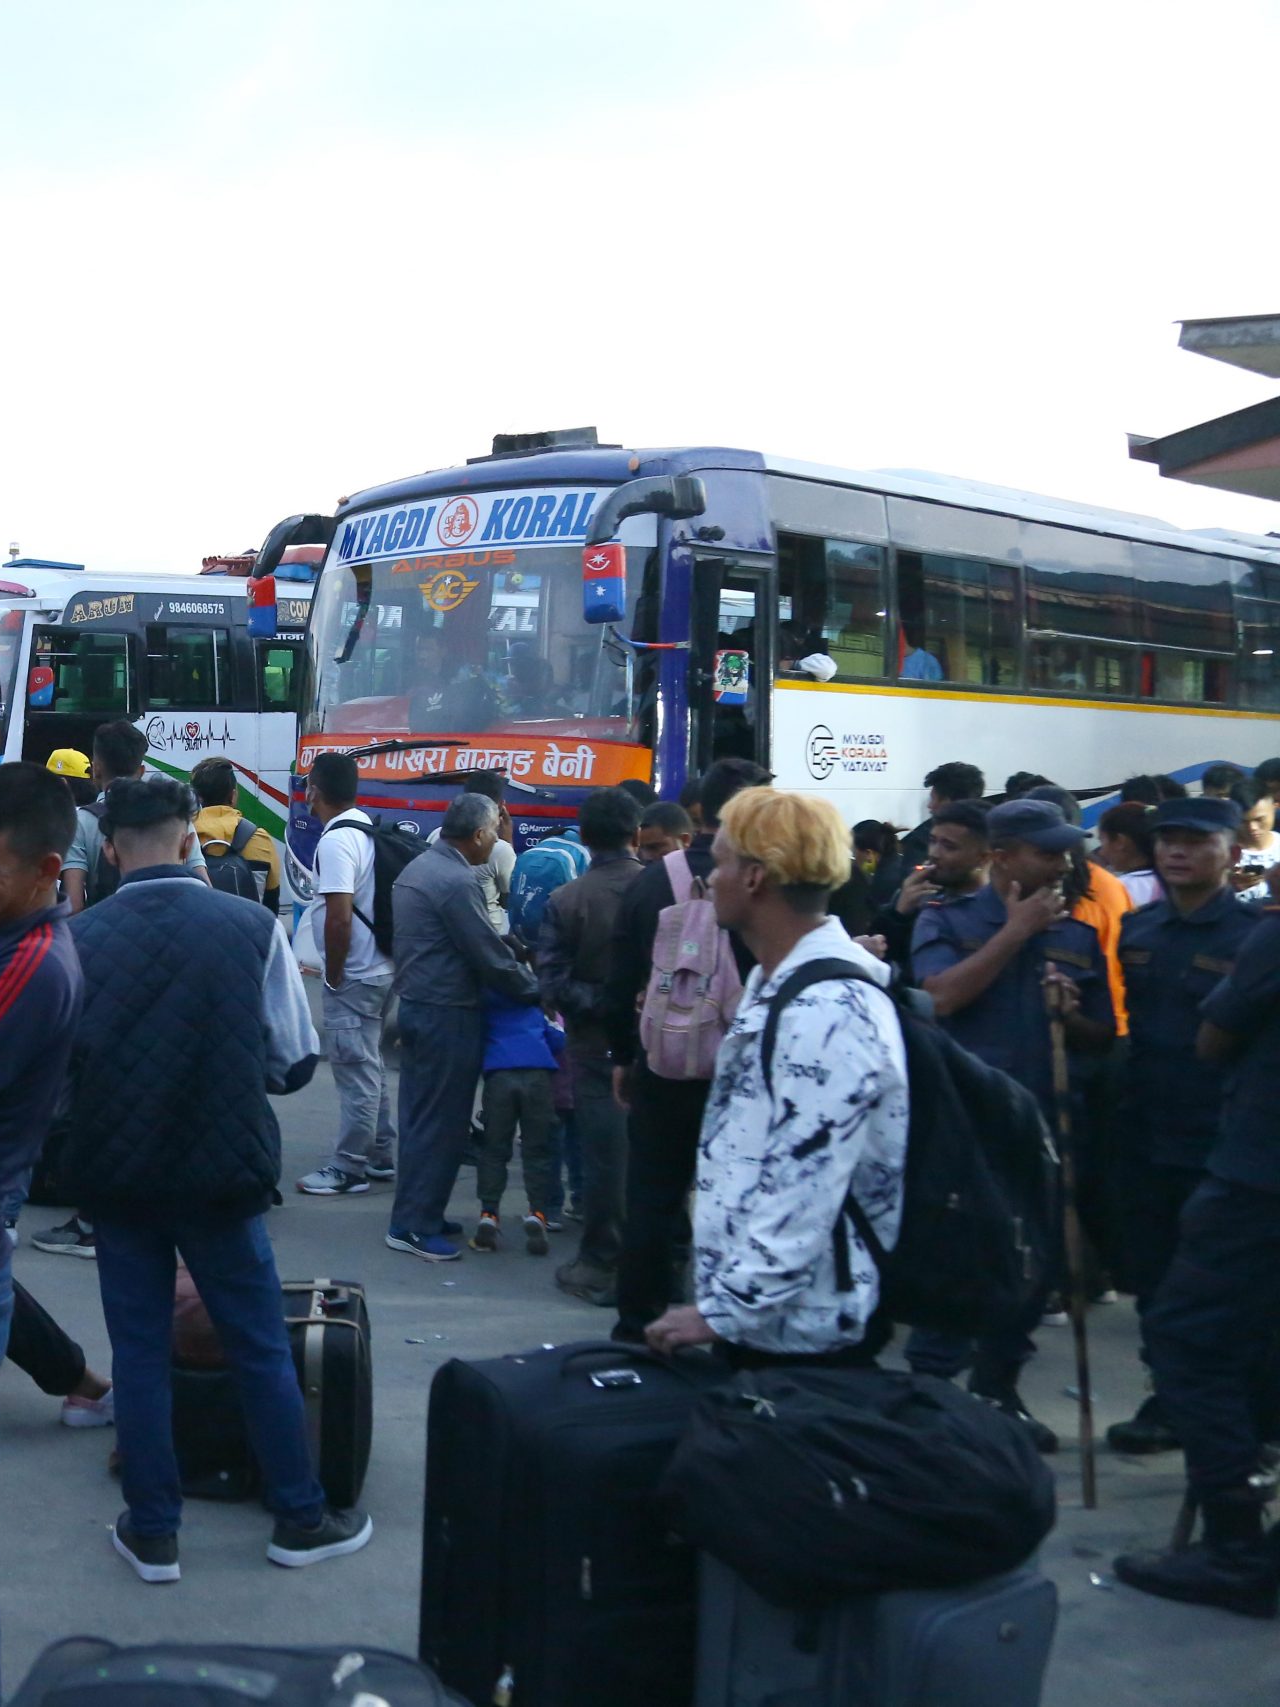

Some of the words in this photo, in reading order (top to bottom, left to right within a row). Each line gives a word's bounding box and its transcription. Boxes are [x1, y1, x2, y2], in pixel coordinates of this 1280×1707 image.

[337, 506, 437, 561] MYAGDI
[392, 550, 516, 574] AIRBUS
[434, 582, 462, 600] AC
[70, 594, 135, 623] ARUN
[169, 602, 225, 614] 9846068575
[843, 734, 885, 745] MYAGDI
[542, 743, 596, 780] बेनी
[841, 747, 888, 759] KORALA
[841, 761, 888, 772] YATAYAT
